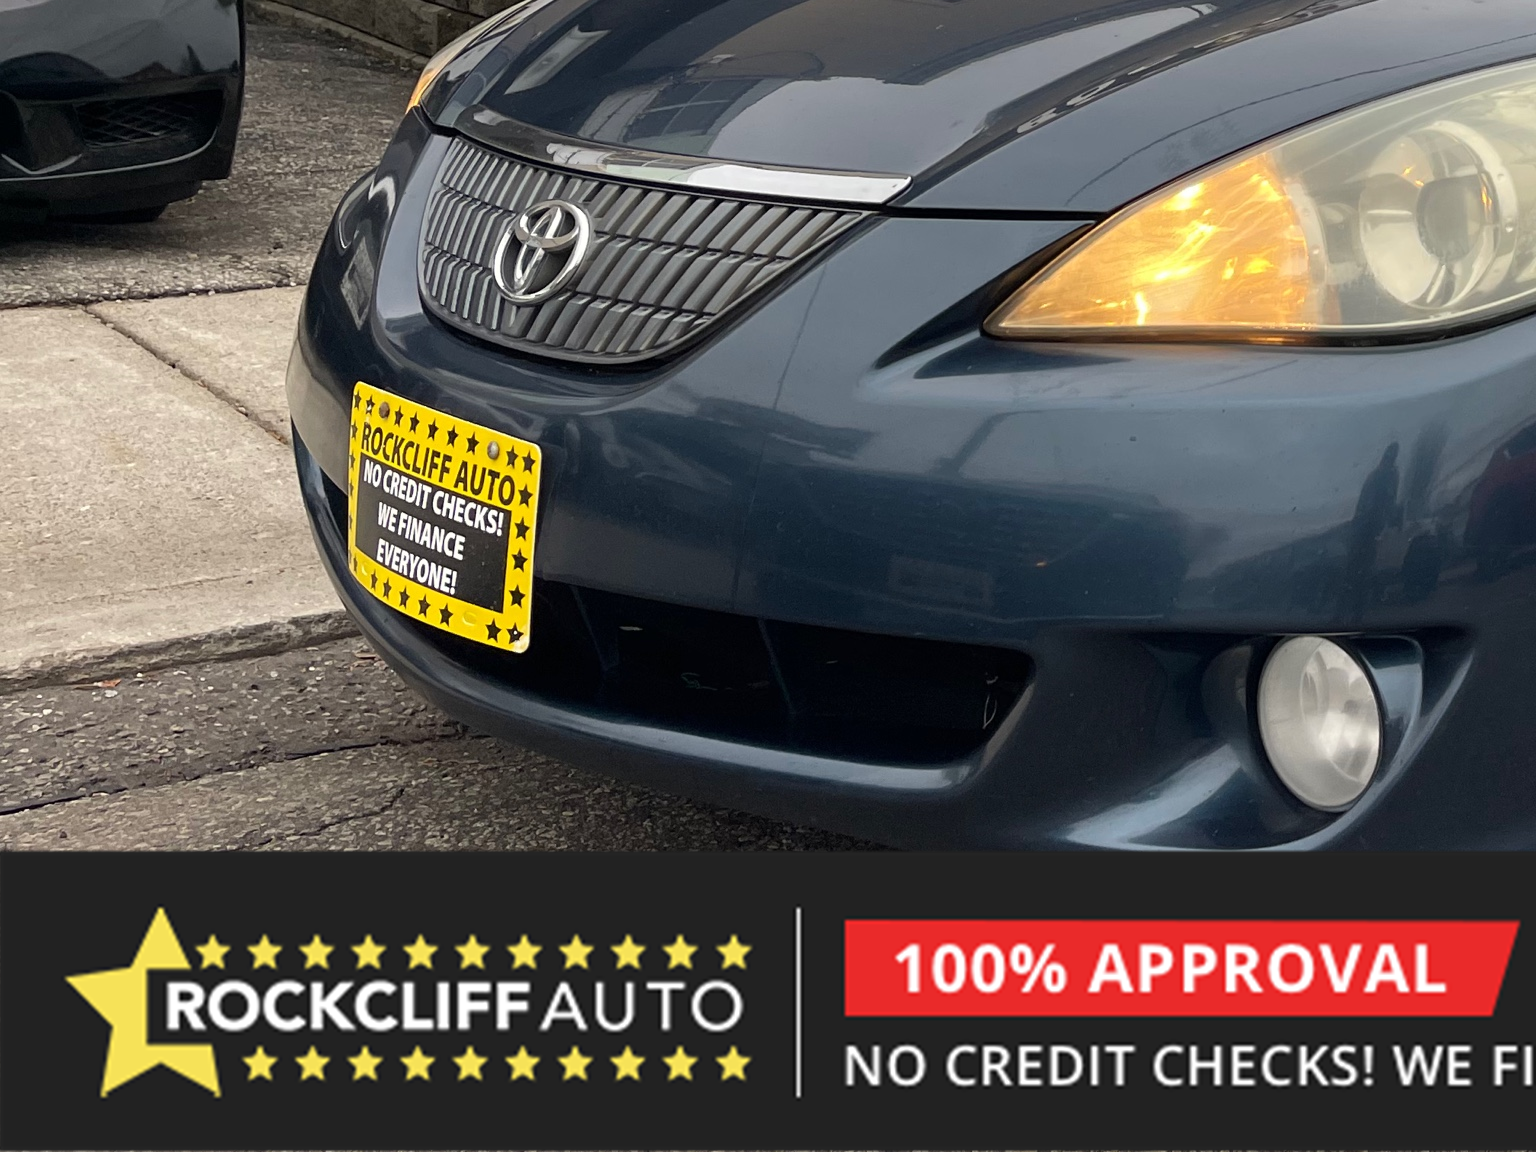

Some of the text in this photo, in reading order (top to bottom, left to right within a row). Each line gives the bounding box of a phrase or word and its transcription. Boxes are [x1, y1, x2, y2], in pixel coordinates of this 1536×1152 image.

[361, 421, 515, 505] ROCKCLIFF AUTO
[363, 459, 504, 536] NO CREDIT CHECKS!
[377, 502, 465, 561] WE FINANCE
[376, 538, 458, 595] EVERYONE!
